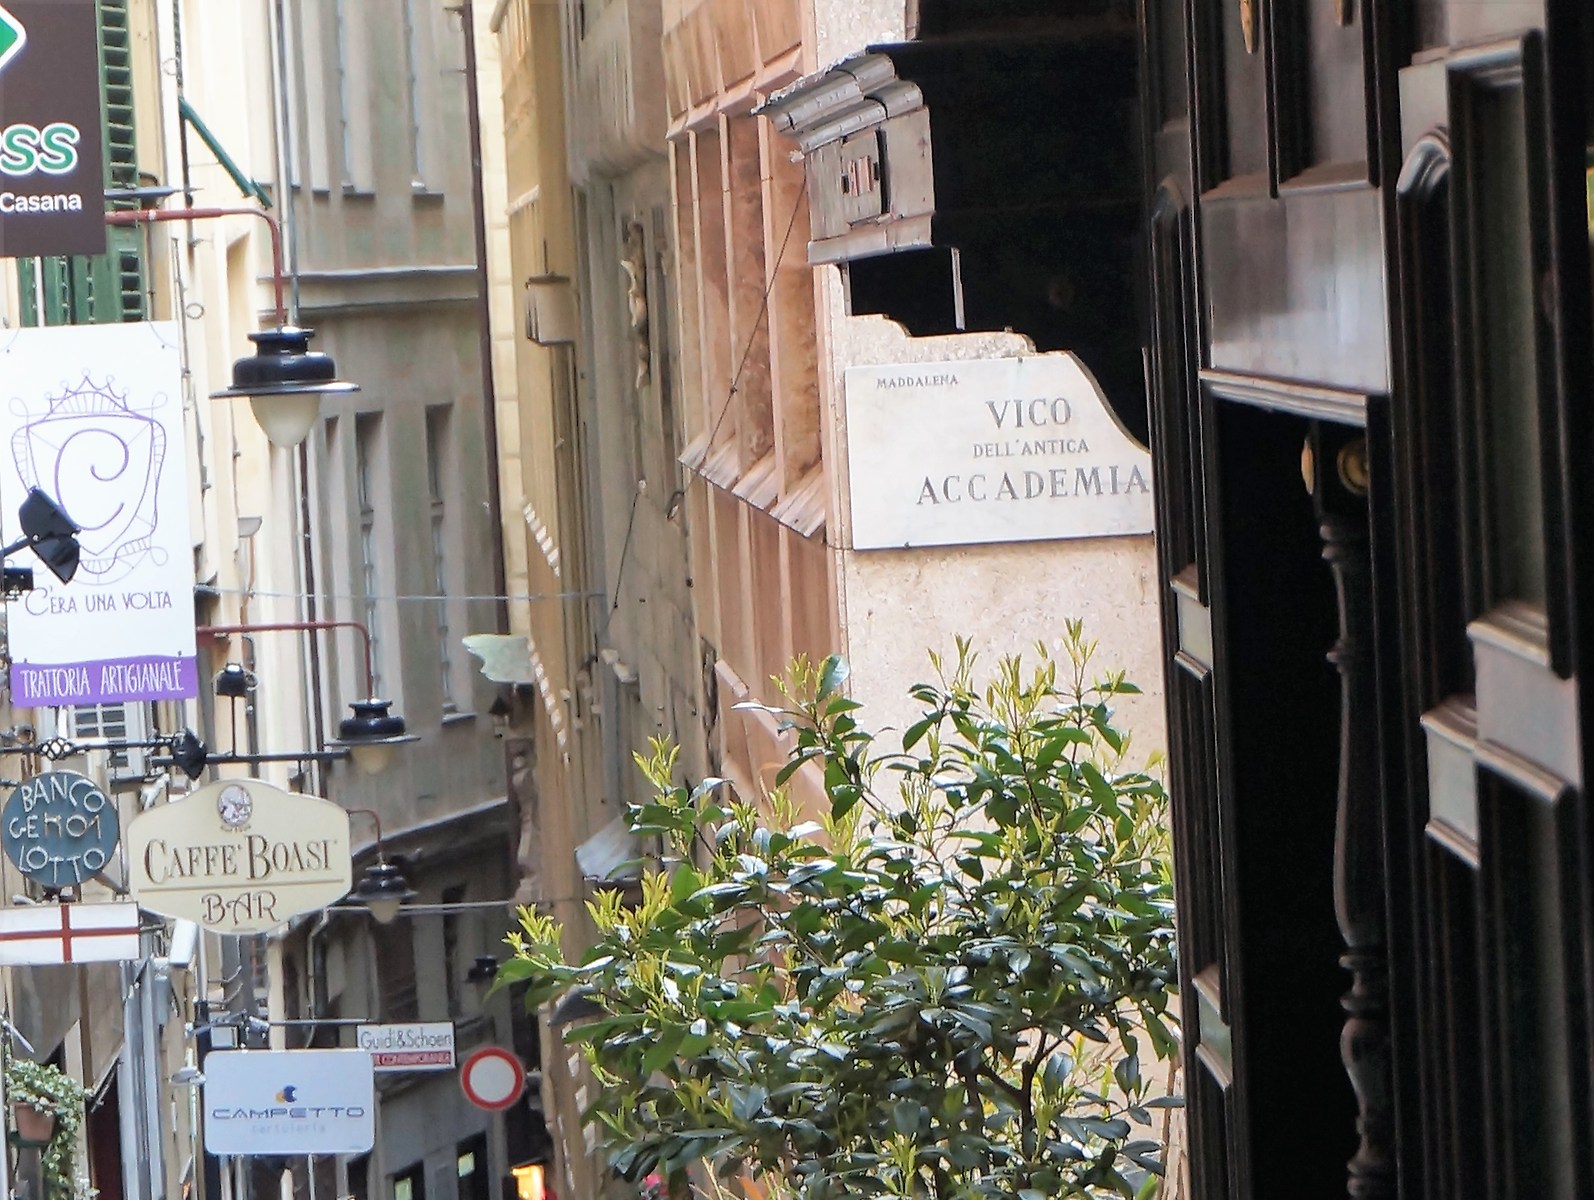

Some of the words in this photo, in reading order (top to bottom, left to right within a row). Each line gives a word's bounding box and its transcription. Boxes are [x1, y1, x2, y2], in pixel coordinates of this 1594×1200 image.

[0, 192, 82, 212] Casana
[876, 374, 959, 389] MADDALENA
[986, 398, 1071, 428] VICO
[972, 438, 1090, 458] DELL'ANTICA
[916, 464, 1150, 505] ACCADEMIA
[85, 593, 117, 612] UNA
[122, 591, 172, 610] VOLTA
[20, 667, 91, 698] TRATTORIA
[100, 660, 184, 695] ARTIGIANALE
[21, 775, 105, 813] BANCO
[19, 845, 105, 884] LOTTO
[200, 890, 280, 925] BAR
[212, 1106, 366, 1120] CAMPETTO
